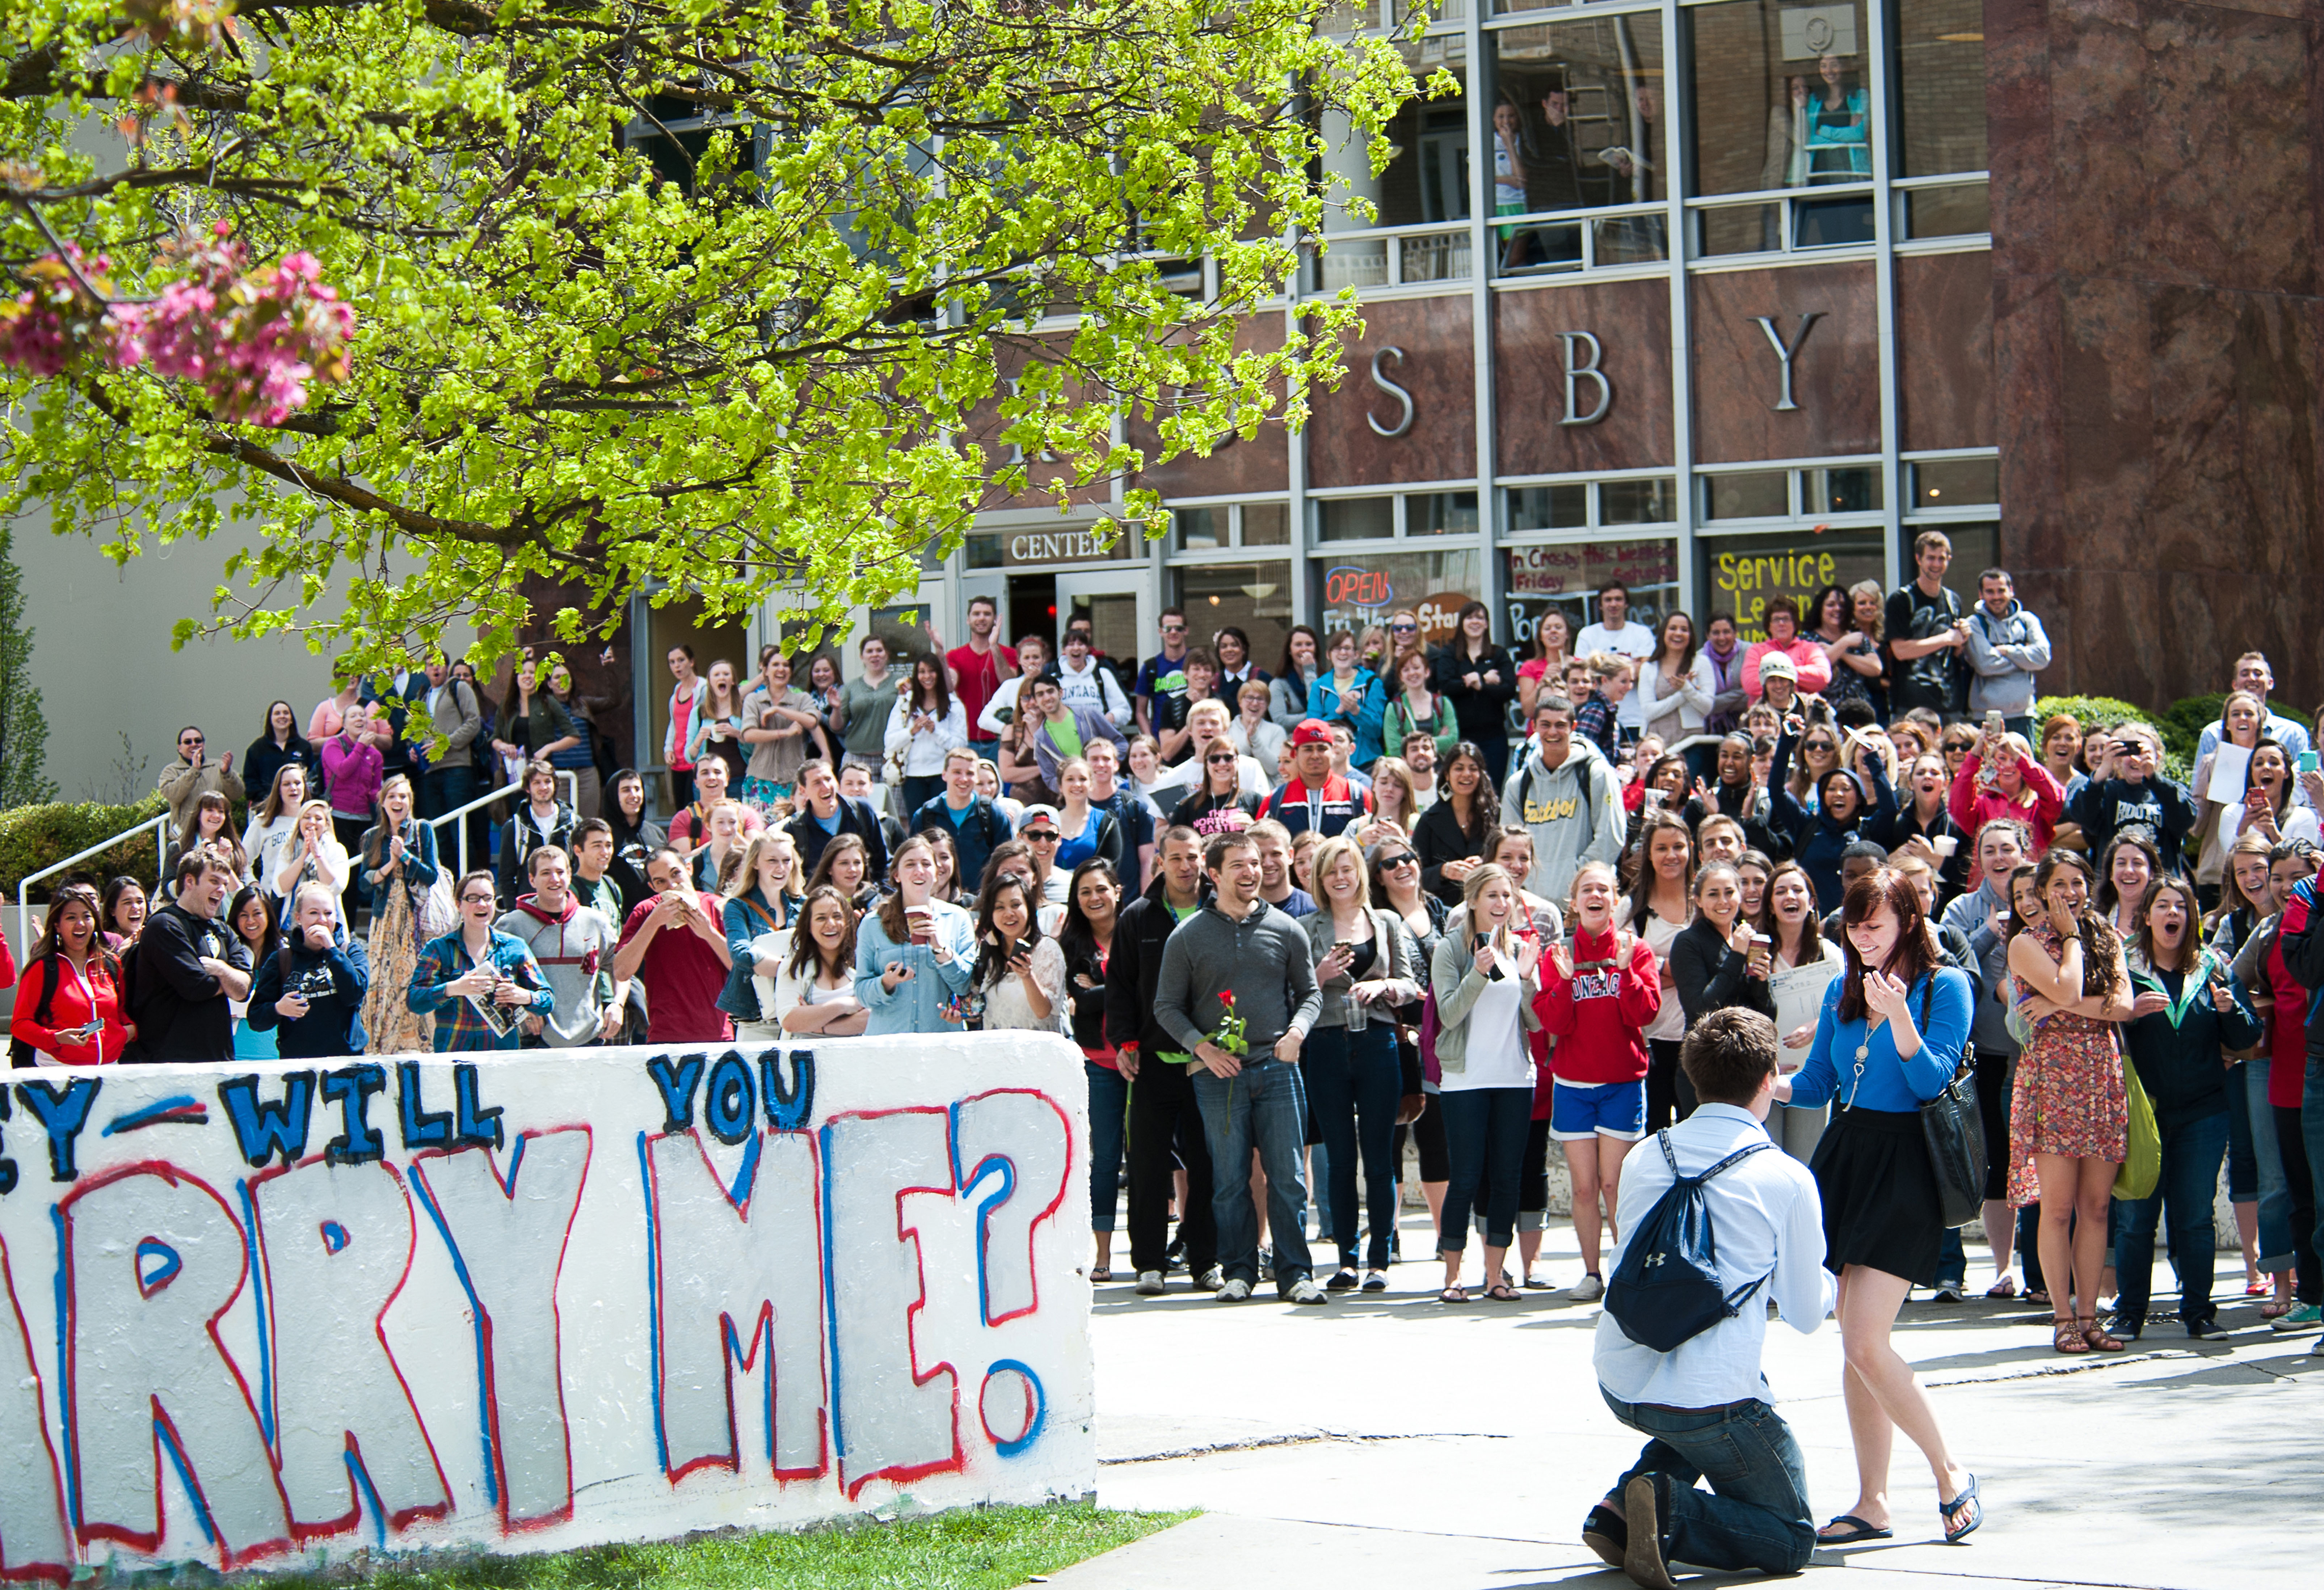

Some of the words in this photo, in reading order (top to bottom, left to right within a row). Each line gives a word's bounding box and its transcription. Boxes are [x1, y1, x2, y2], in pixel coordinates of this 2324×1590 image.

[1011, 531, 1109, 560] CENTER
[1529, 548, 1579, 570] Crosby
[1515, 573, 1565, 593] Friday
[1718, 549, 1835, 590] Service
[1327, 571, 1389, 603] OPEN
[1193, 817, 1228, 828] NORTH
[1208, 809, 1228, 817] THE
[2114, 800, 2162, 828] ROOTS
[1572, 972, 1620, 1002] ONZAG
[0, 1076, 103, 1195] Y
[218, 1060, 504, 1167] WILL
[647, 1048, 816, 1146] YOU
[637, 1088, 1072, 1502] ME?
